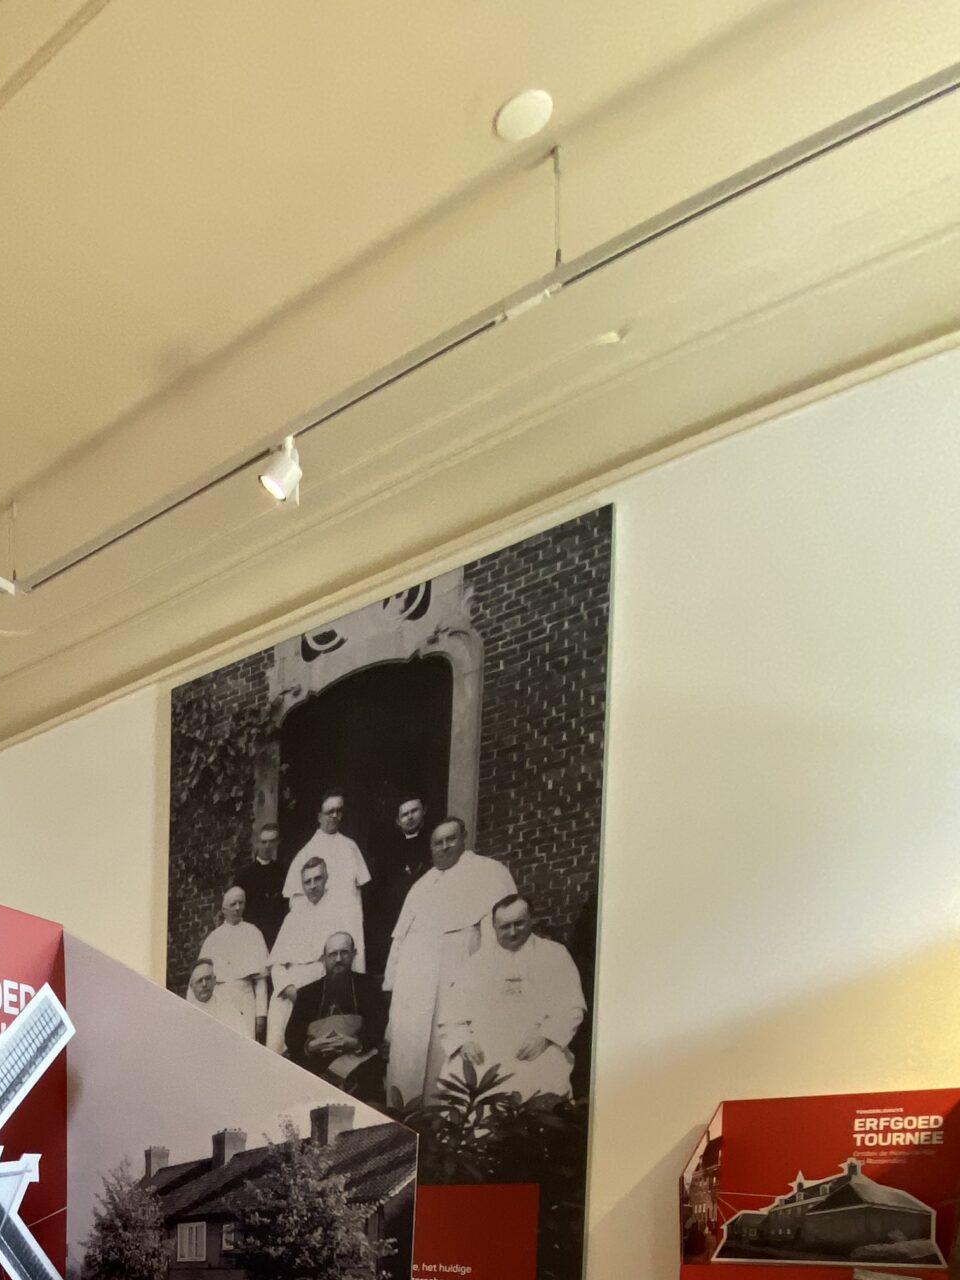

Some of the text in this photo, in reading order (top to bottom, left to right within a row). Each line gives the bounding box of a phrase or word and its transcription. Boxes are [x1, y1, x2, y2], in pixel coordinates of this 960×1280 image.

[854, 1115, 944, 1131] ERFGOED
[853, 1131, 944, 1146] TOURNEE
[422, 1263, 437, 1272] het
[439, 1264, 472, 1275] huidige
